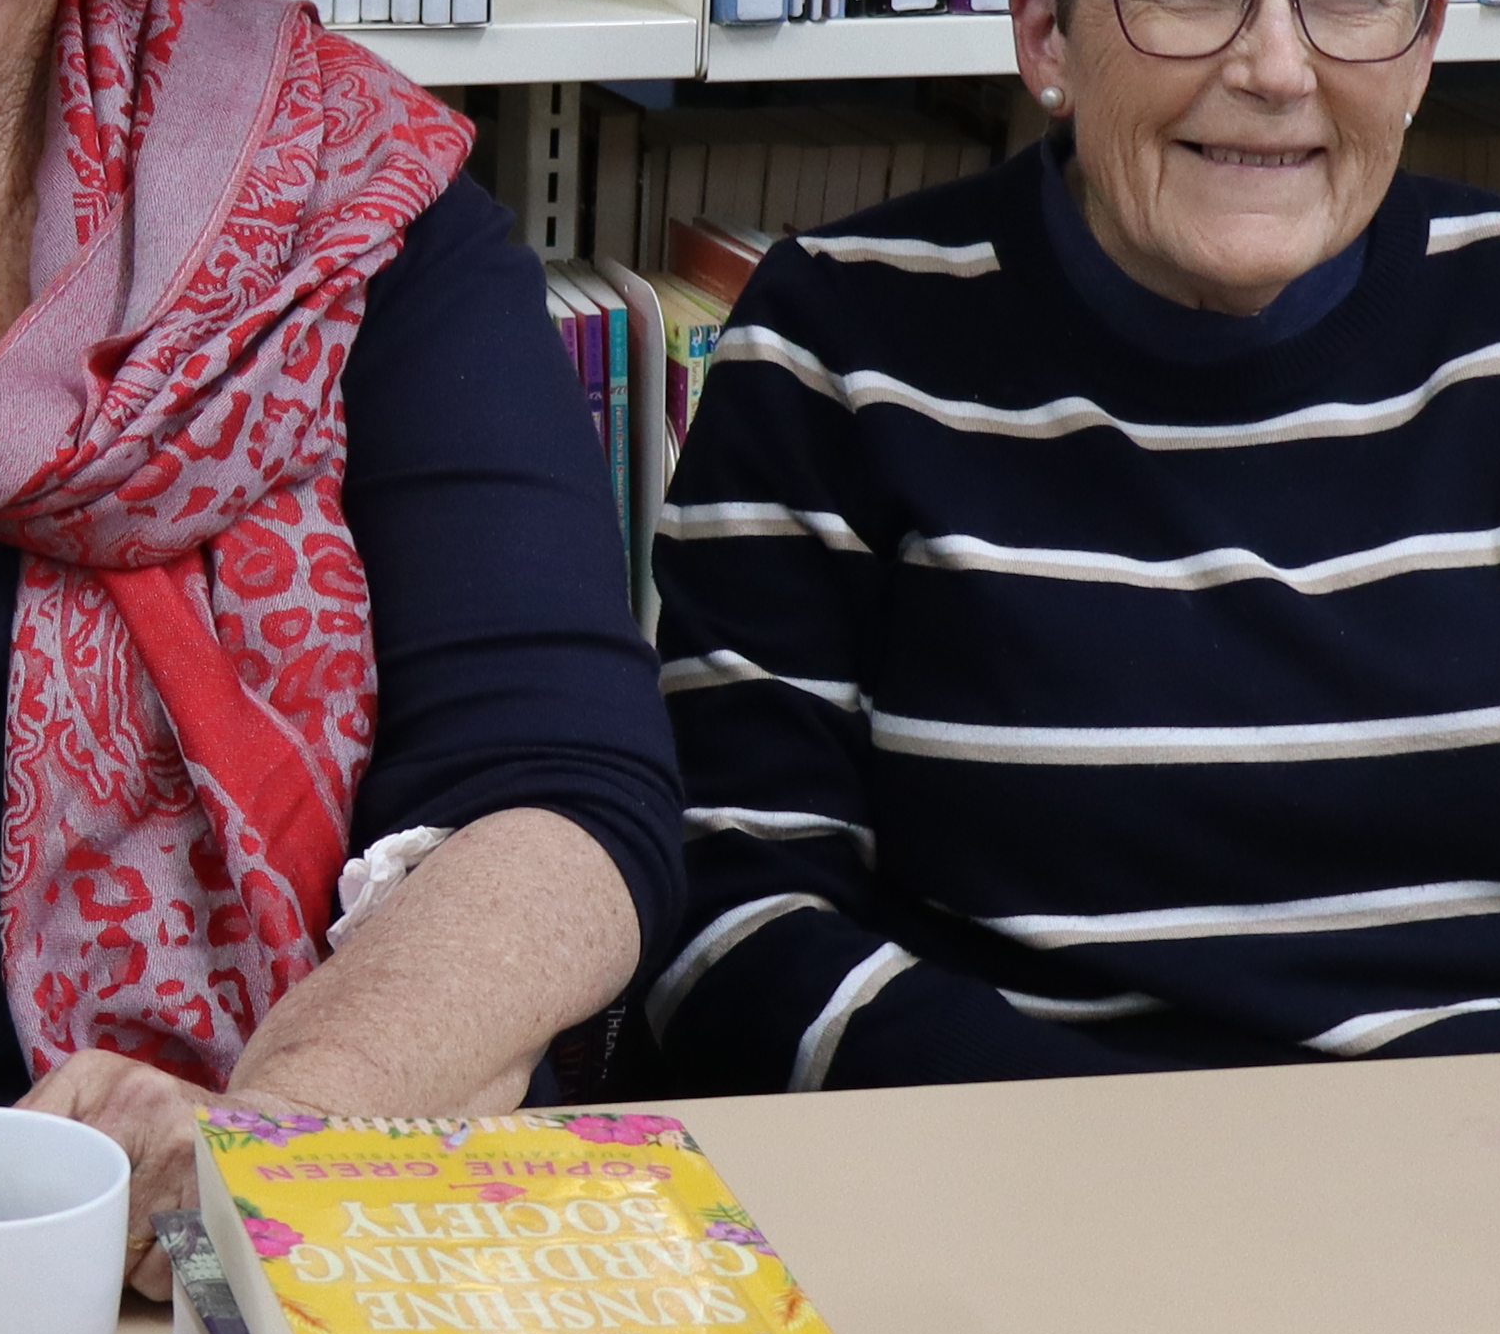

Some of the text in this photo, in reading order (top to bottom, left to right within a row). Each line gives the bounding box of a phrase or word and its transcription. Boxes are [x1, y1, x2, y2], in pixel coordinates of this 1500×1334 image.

[257, 1160, 672, 1180] SOPHIE GREEN
[342, 1200, 667, 1240] SOCIETY
[288, 1241, 759, 1285] GARDENING
[356, 1288, 746, 1332] SUNSHINE
